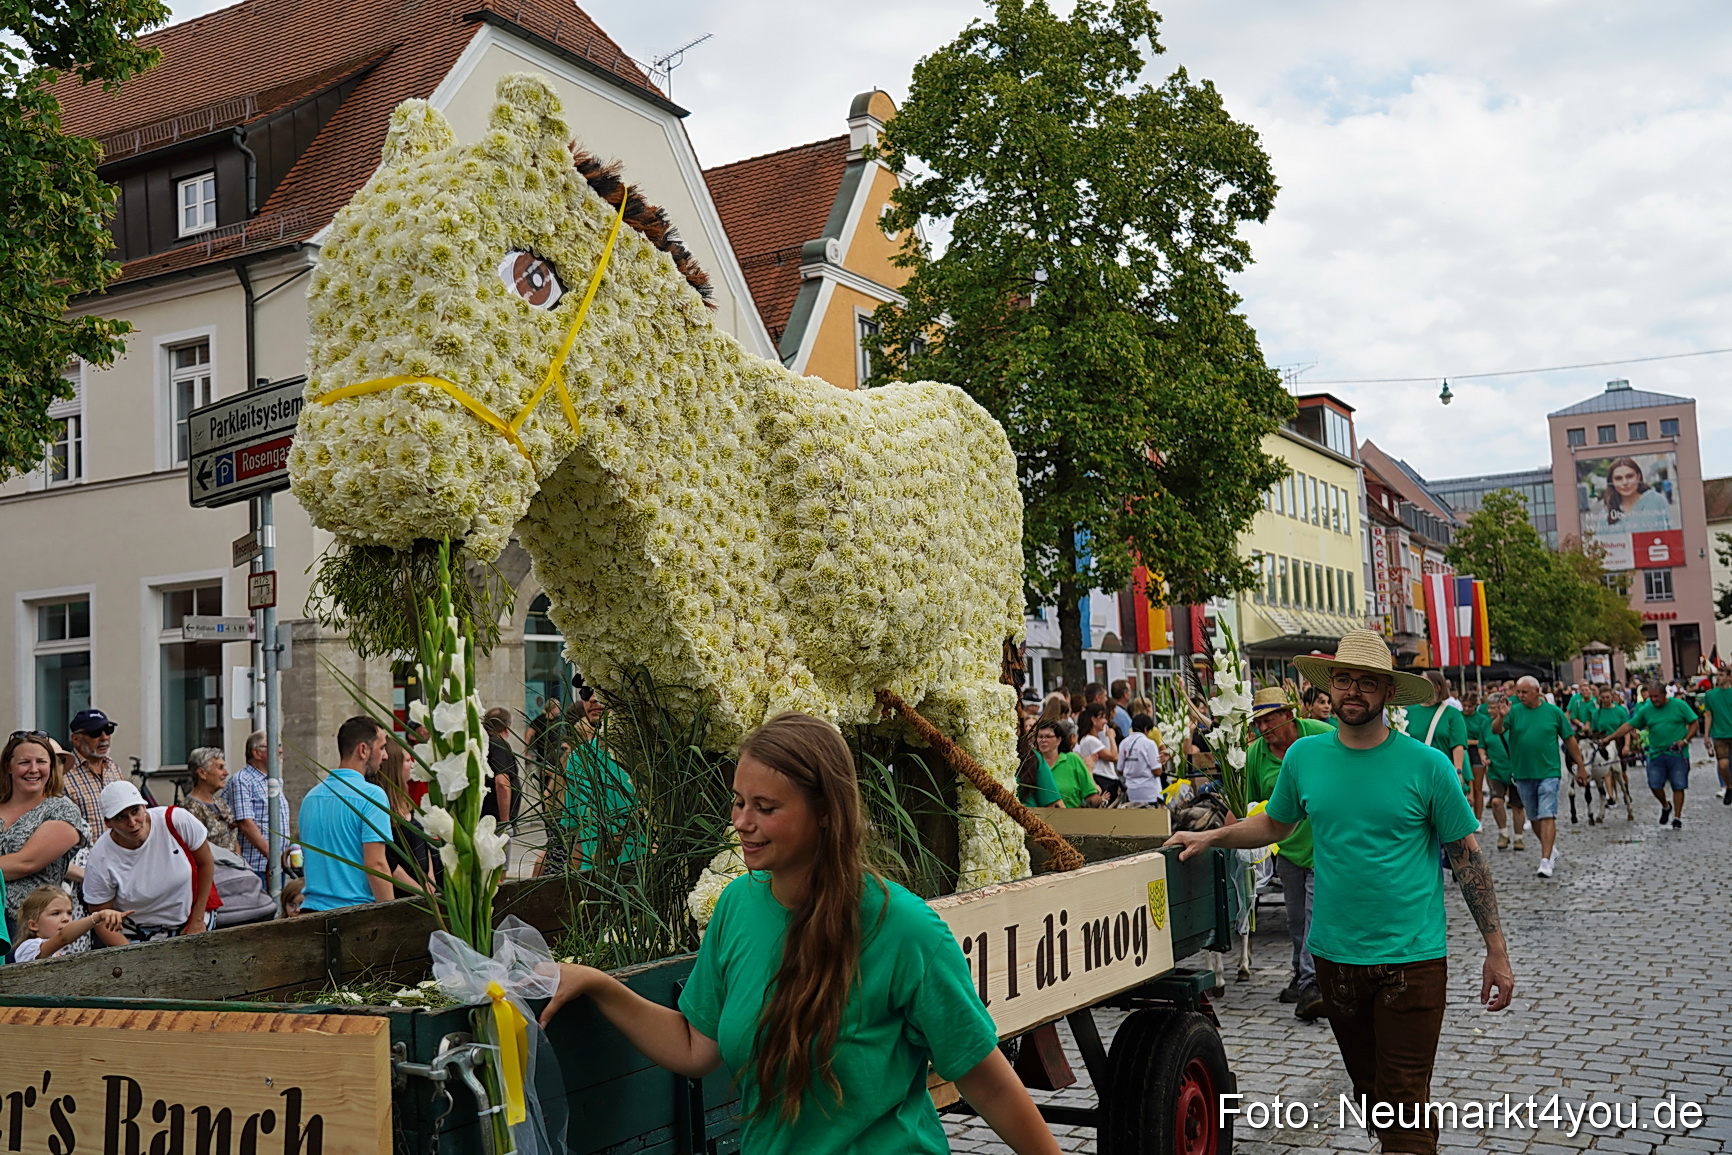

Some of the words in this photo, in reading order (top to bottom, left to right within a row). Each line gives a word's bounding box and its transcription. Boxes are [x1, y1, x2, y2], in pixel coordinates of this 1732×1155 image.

[210, 396, 304, 441] Parkleitsystem
[221, 465, 229, 484] P
[1640, 611, 1677, 620] rkasse
[1004, 924, 1021, 1001] I
[1036, 909, 1072, 991] di
[1081, 904, 1149, 973] mog
[0, 1070, 77, 1155] r's
[102, 1075, 324, 1155] Ranch
